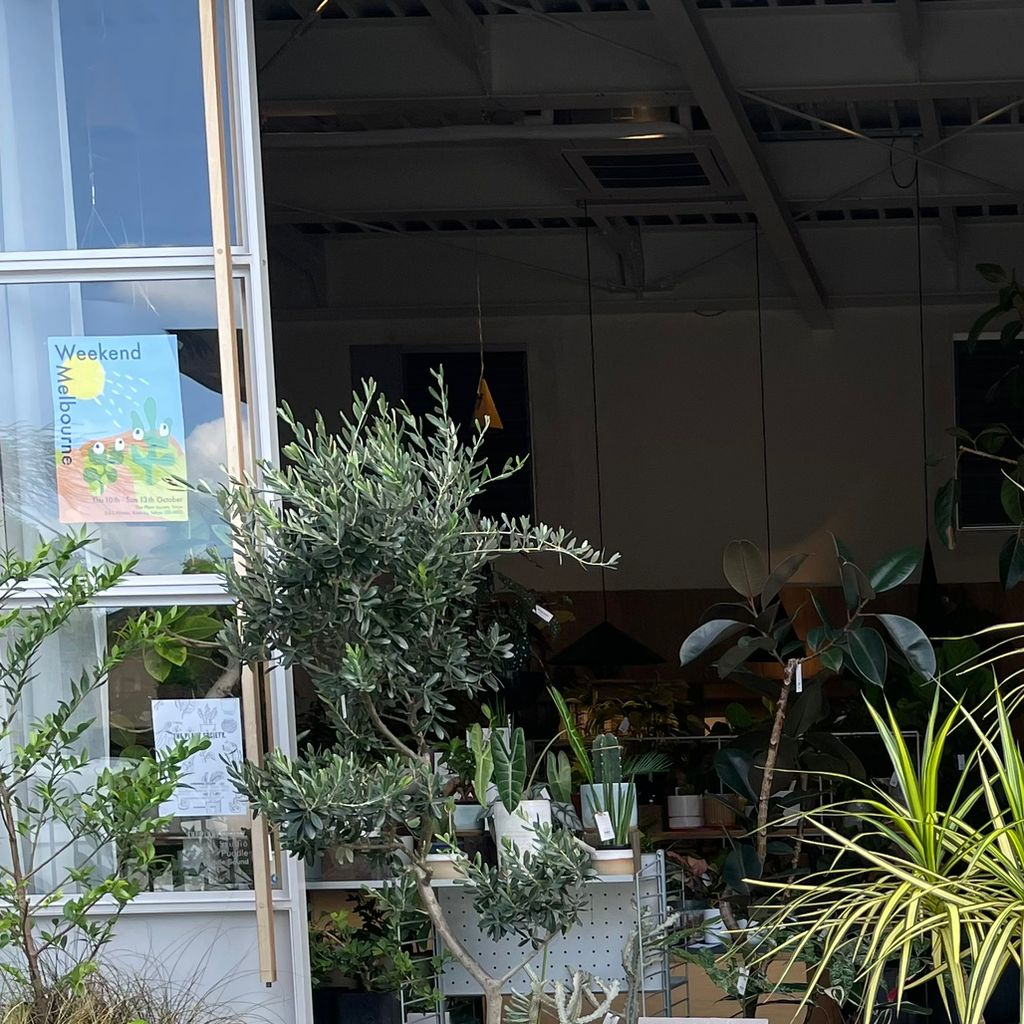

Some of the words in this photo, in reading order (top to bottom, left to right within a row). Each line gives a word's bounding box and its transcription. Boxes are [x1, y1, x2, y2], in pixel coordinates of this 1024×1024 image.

[55, 342, 141, 361] Weekend
[56, 365, 77, 466] Melbourne
[156, 495, 183, 503] October
